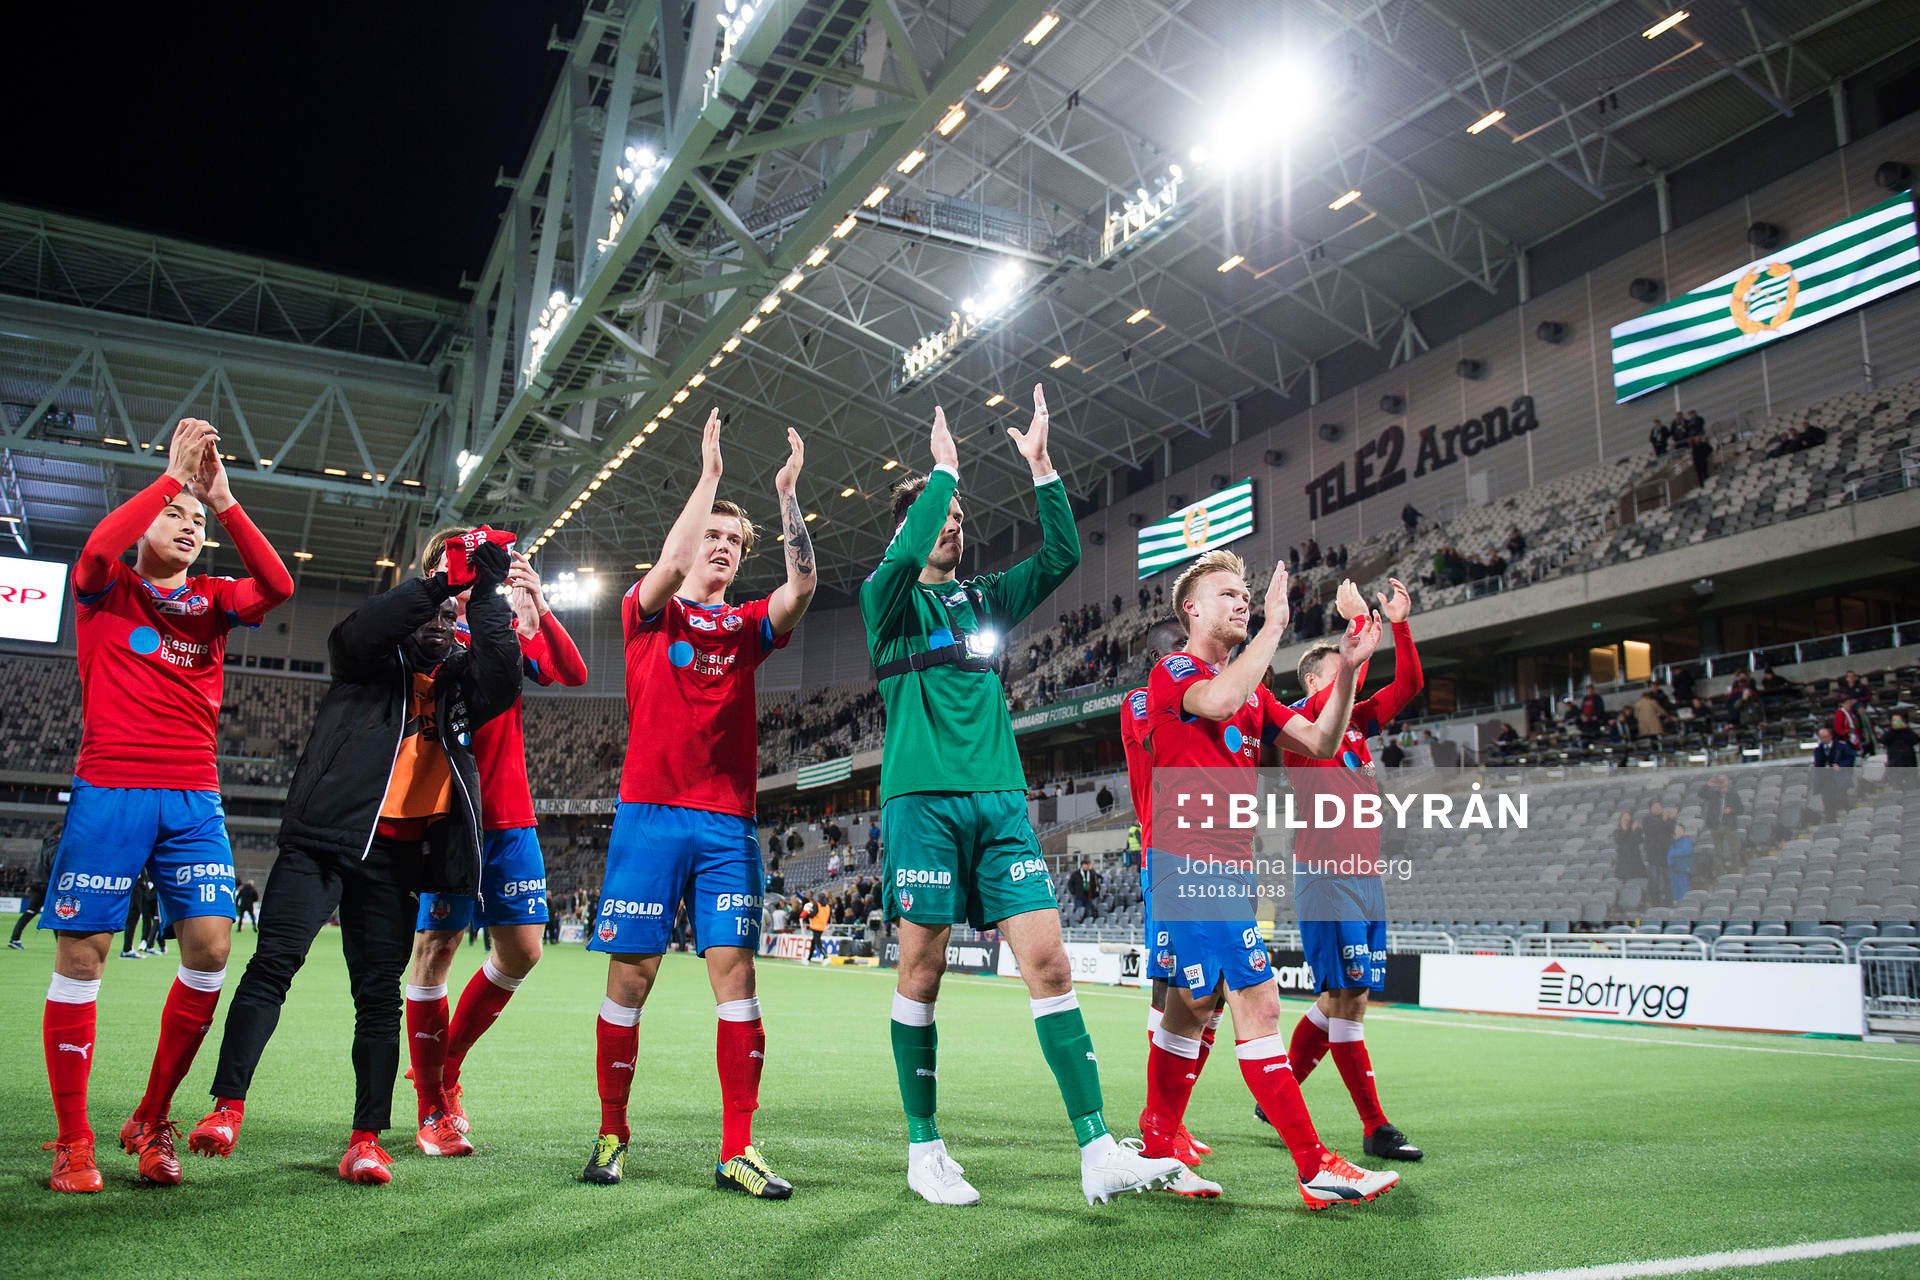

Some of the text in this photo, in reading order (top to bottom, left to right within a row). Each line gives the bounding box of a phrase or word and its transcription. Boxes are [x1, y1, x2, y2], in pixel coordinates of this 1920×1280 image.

[1305, 395, 1539, 520] TELE2 Arena
[163, 633, 209, 655] Resurs
[160, 646, 194, 668] Bank
[696, 648, 735, 665] Resurs
[693, 660, 723, 675] Bank
[76, 873, 132, 890] SOLID
[906, 869, 951, 885] SOLID
[198, 883, 215, 902] 18
[614, 899, 663, 916] SOLID
[735, 916, 750, 936] 13
[1567, 974, 1689, 1020] Botrygg
